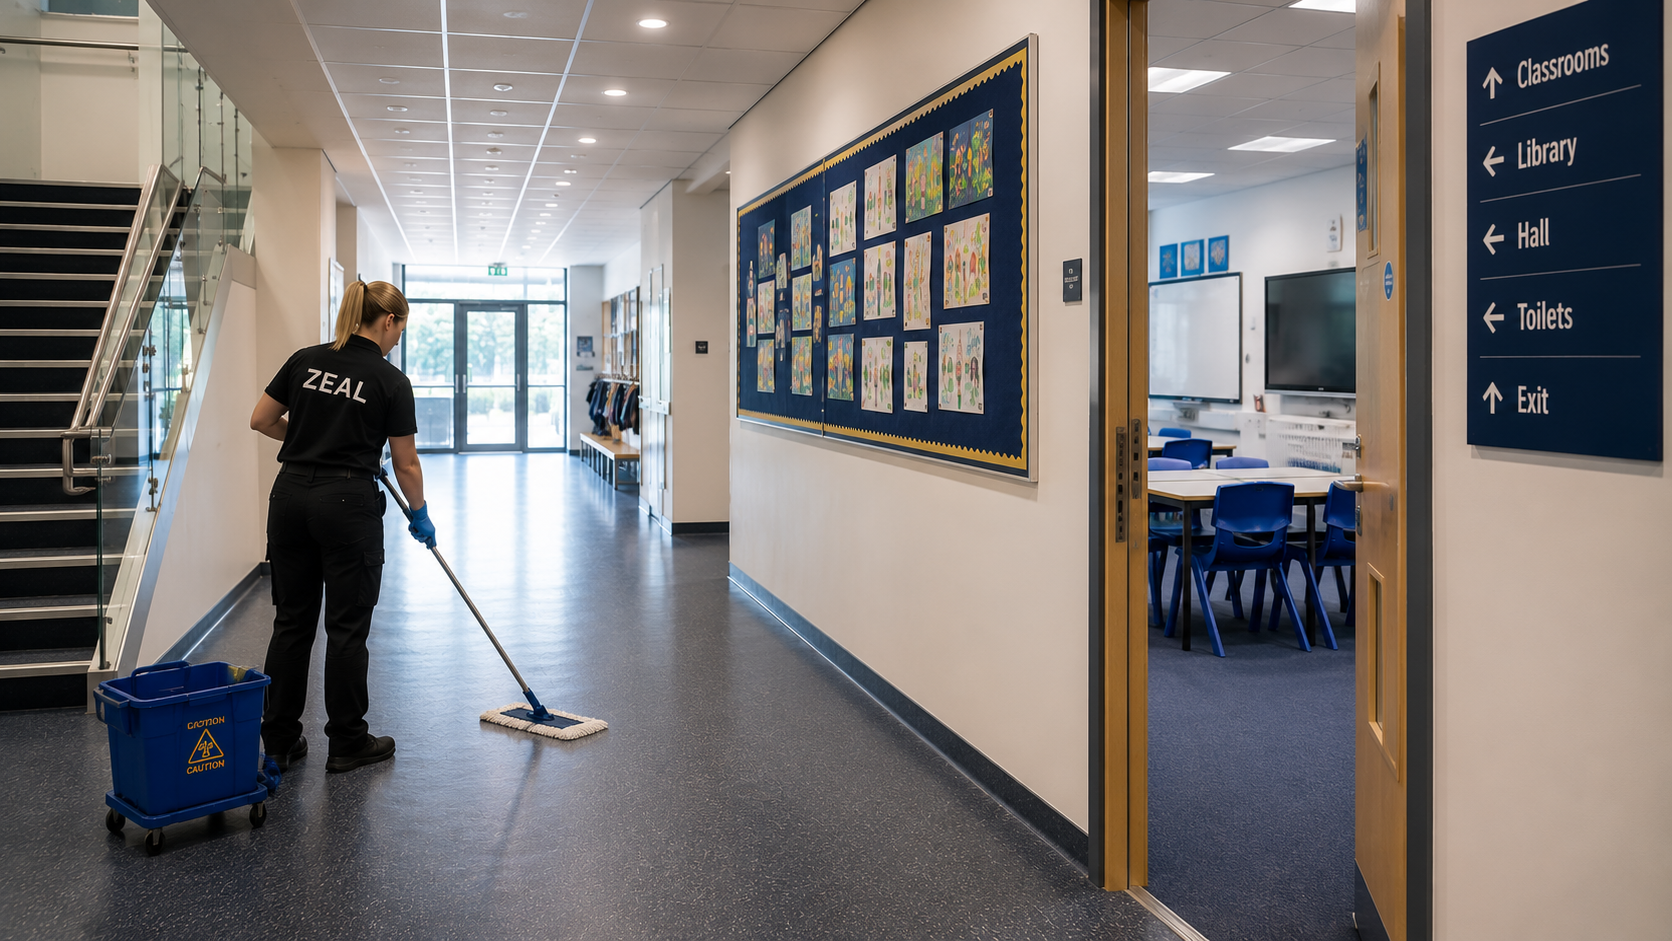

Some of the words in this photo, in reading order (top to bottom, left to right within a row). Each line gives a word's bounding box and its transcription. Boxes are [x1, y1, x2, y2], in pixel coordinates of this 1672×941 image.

[1517, 43, 1610, 89] Classrooms
[1517, 136, 1578, 169] Library
[1517, 217, 1550, 250] Hall
[1517, 300, 1573, 331] Toilets
[302, 368, 367, 404] ZEAL
[1517, 385, 1549, 415] Exit
[187, 760, 225, 774] CAUTION
